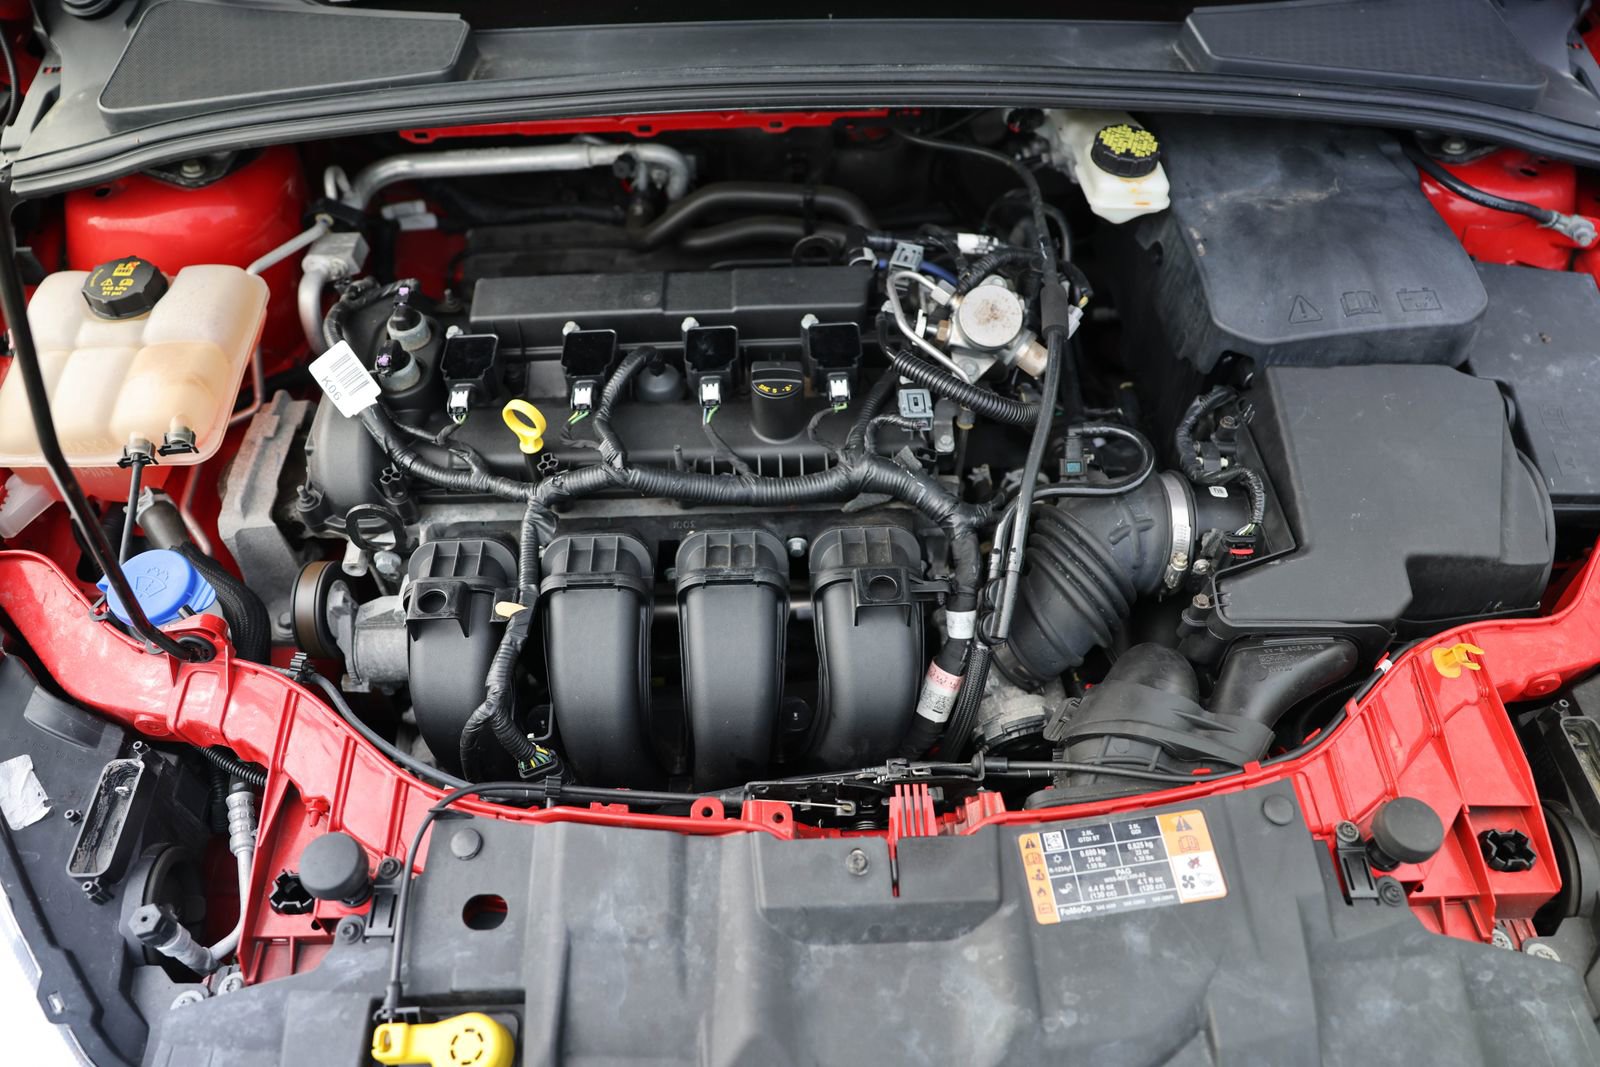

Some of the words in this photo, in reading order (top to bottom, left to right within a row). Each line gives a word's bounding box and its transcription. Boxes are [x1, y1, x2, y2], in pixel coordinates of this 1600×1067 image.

[321, 375, 343, 401] K06
[1143, 840, 1154, 849] kg
[1096, 847, 1107, 856] kg
